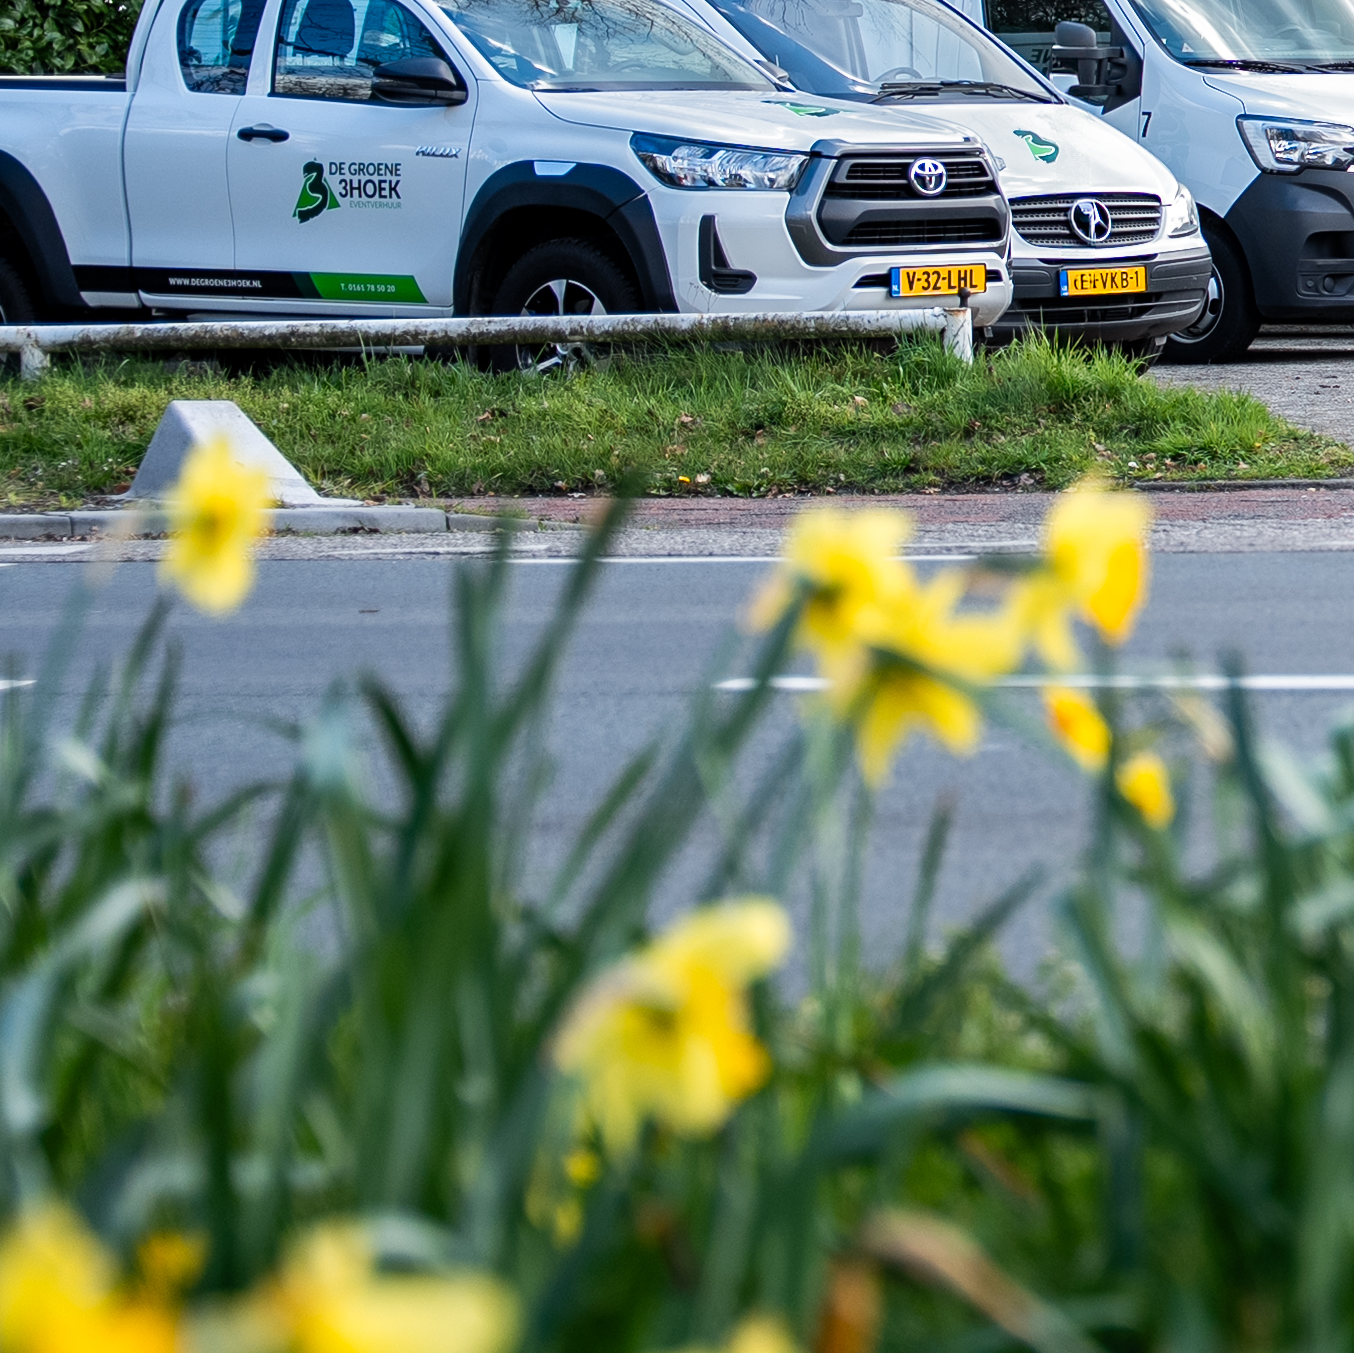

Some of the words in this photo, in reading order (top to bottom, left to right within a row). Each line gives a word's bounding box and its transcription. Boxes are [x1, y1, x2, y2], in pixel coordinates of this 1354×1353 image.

[415, 145, 462, 159] HILUX
[328, 161, 346, 176] DE
[348, 162, 402, 177] GROENE
[338, 178, 402, 199] 3HOEK
[349, 200, 402, 210] EVENTVERHUUR
[168, 277, 263, 288] WWW.DEGROENE3HOEK.NL
[906, 268, 979, 292] V-32-LHL
[347, 283, 365, 292] 0161
